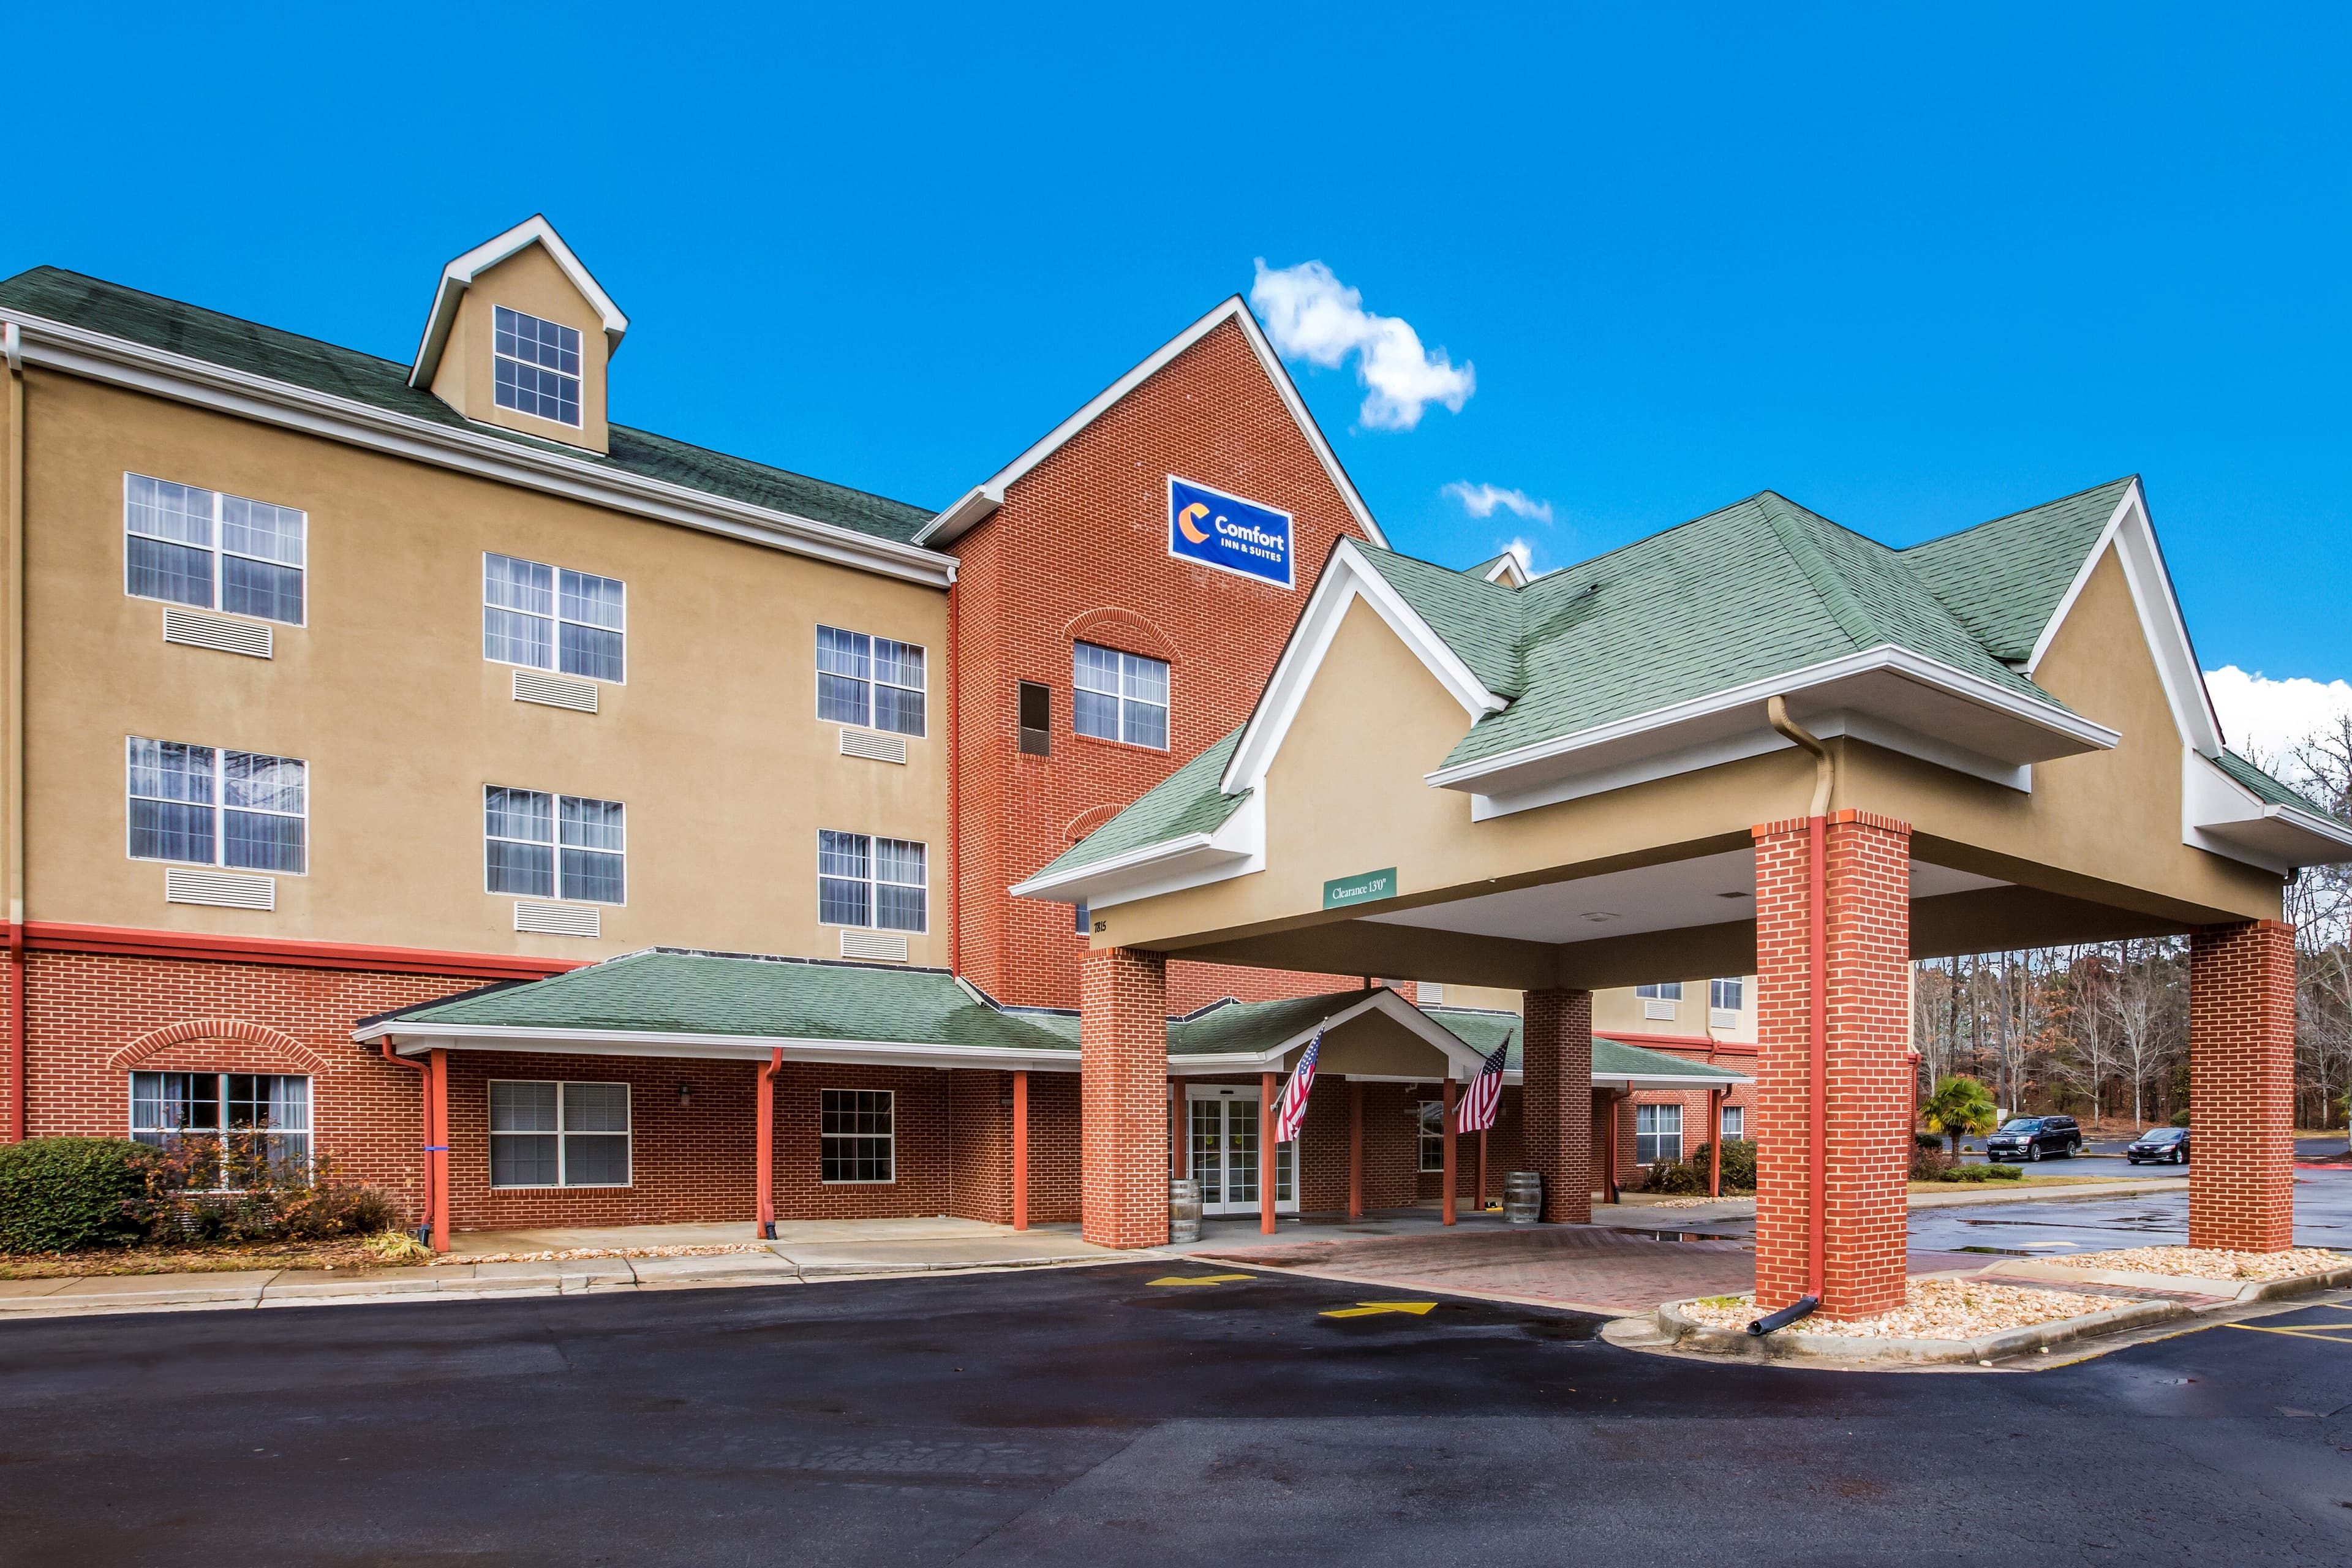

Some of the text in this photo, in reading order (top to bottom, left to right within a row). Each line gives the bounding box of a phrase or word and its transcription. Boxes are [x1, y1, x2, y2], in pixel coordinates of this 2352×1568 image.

[1215, 516, 1284, 551] Comfort
[1221, 537, 1239, 550] INN
[1250, 546, 1281, 562] SUITES
[1332, 886, 1367, 900] Clearance
[1094, 921, 1107, 933] 7815
